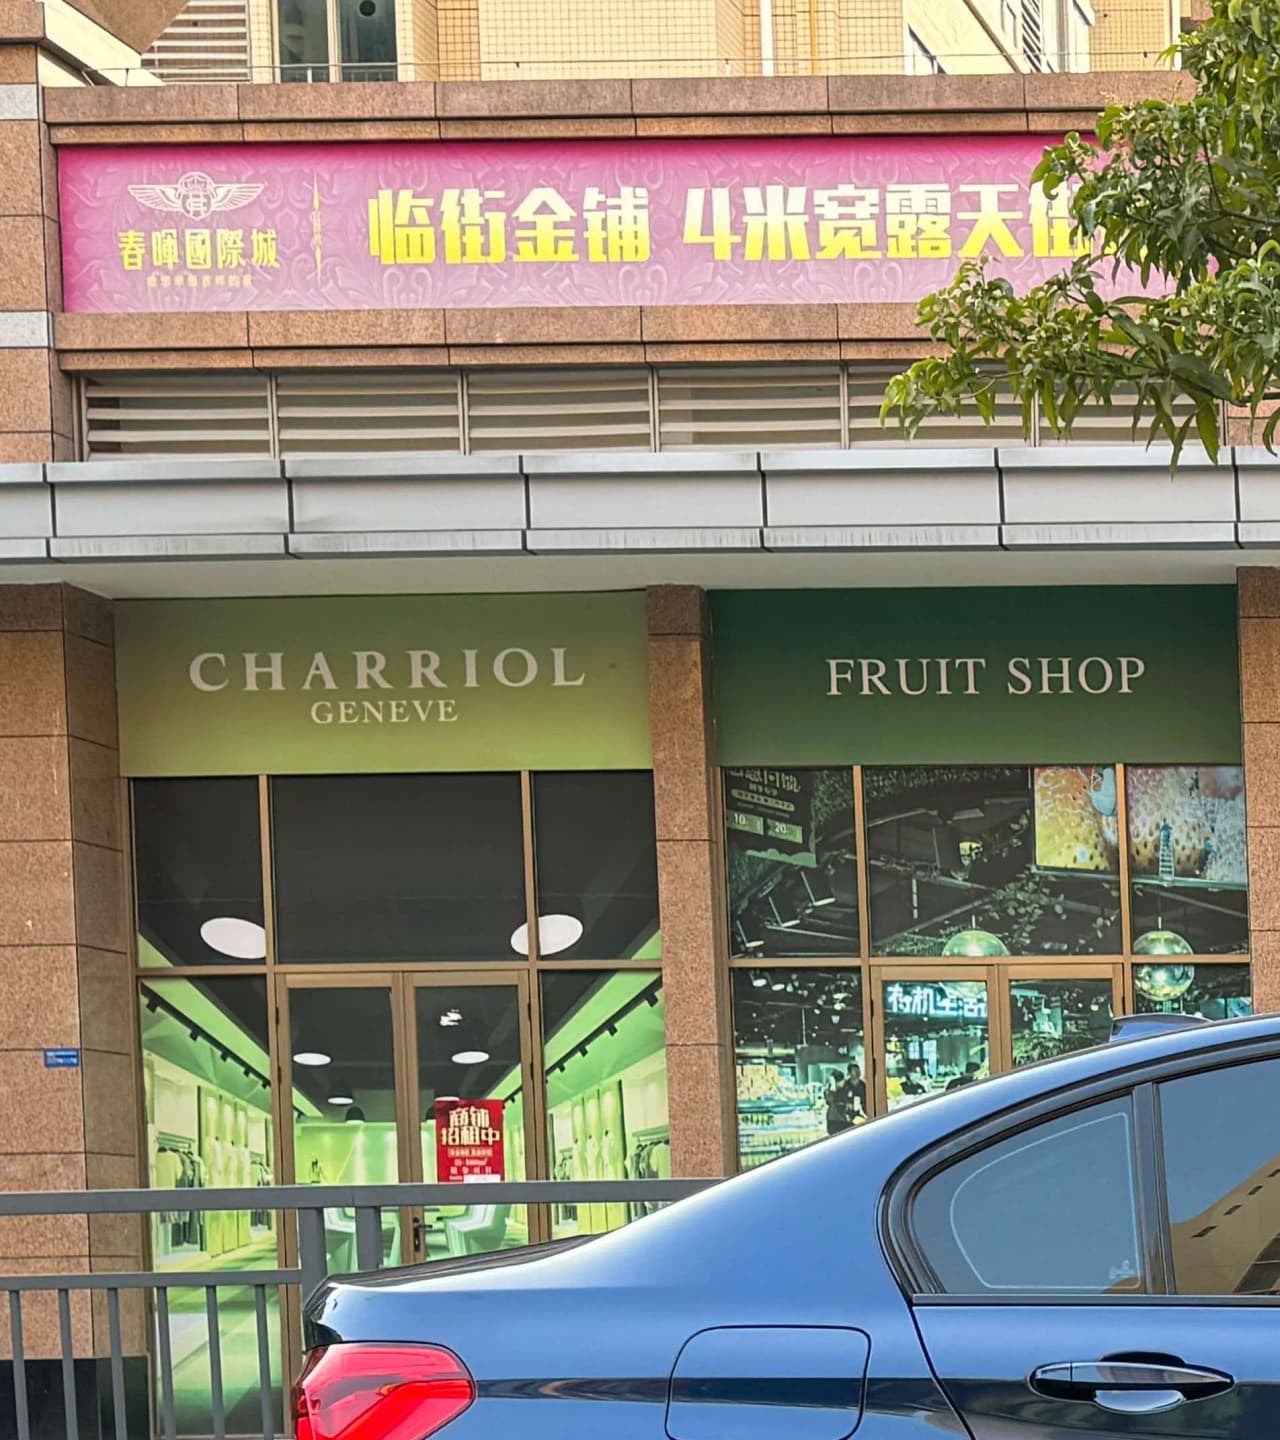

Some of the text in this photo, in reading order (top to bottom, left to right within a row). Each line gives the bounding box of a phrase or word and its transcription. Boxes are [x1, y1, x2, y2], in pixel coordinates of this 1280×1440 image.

[368, 186, 651, 266] 临街金铺
[189, 646, 587, 693] CHARRIOL
[826, 656, 1147, 697] FRUIT SHOP
[310, 699, 459, 725] GENEVE
[441, 1126, 500, 1146] 招租中
